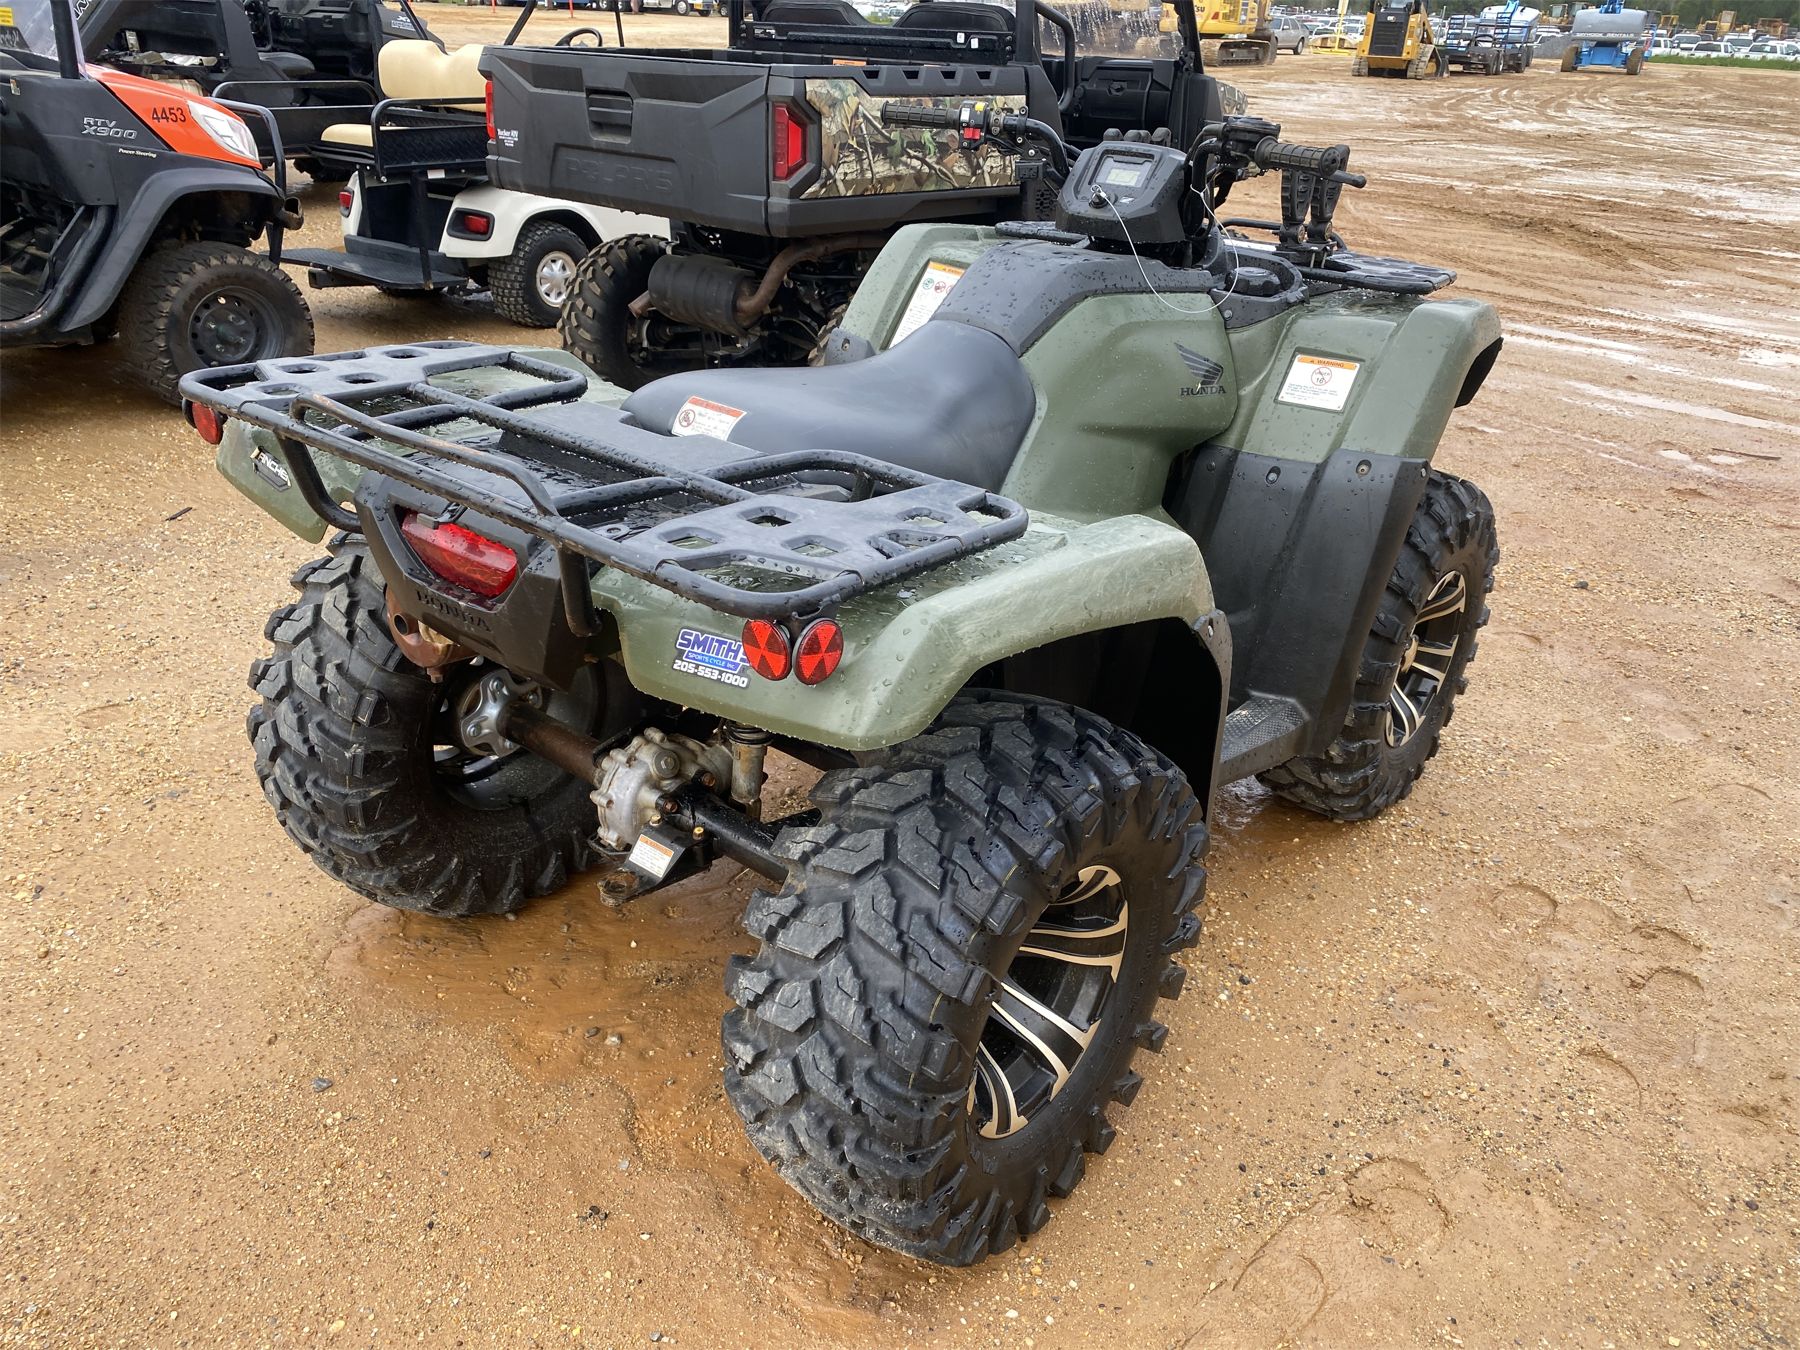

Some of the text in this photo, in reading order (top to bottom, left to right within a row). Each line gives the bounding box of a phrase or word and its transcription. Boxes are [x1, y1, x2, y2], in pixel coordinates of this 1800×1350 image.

[151, 107, 186, 123] 4453
[83, 117, 117, 128] RTV
[81, 125, 138, 139] X900
[564, 157, 673, 191] POLARIS
[1317, 360, 1345, 368] WARNING
[1180, 385, 1226, 397] HONDA
[415, 589, 493, 632] HONDA
[709, 658, 726, 667] CYCLE
[673, 659, 749, 688] 205-553-1000
